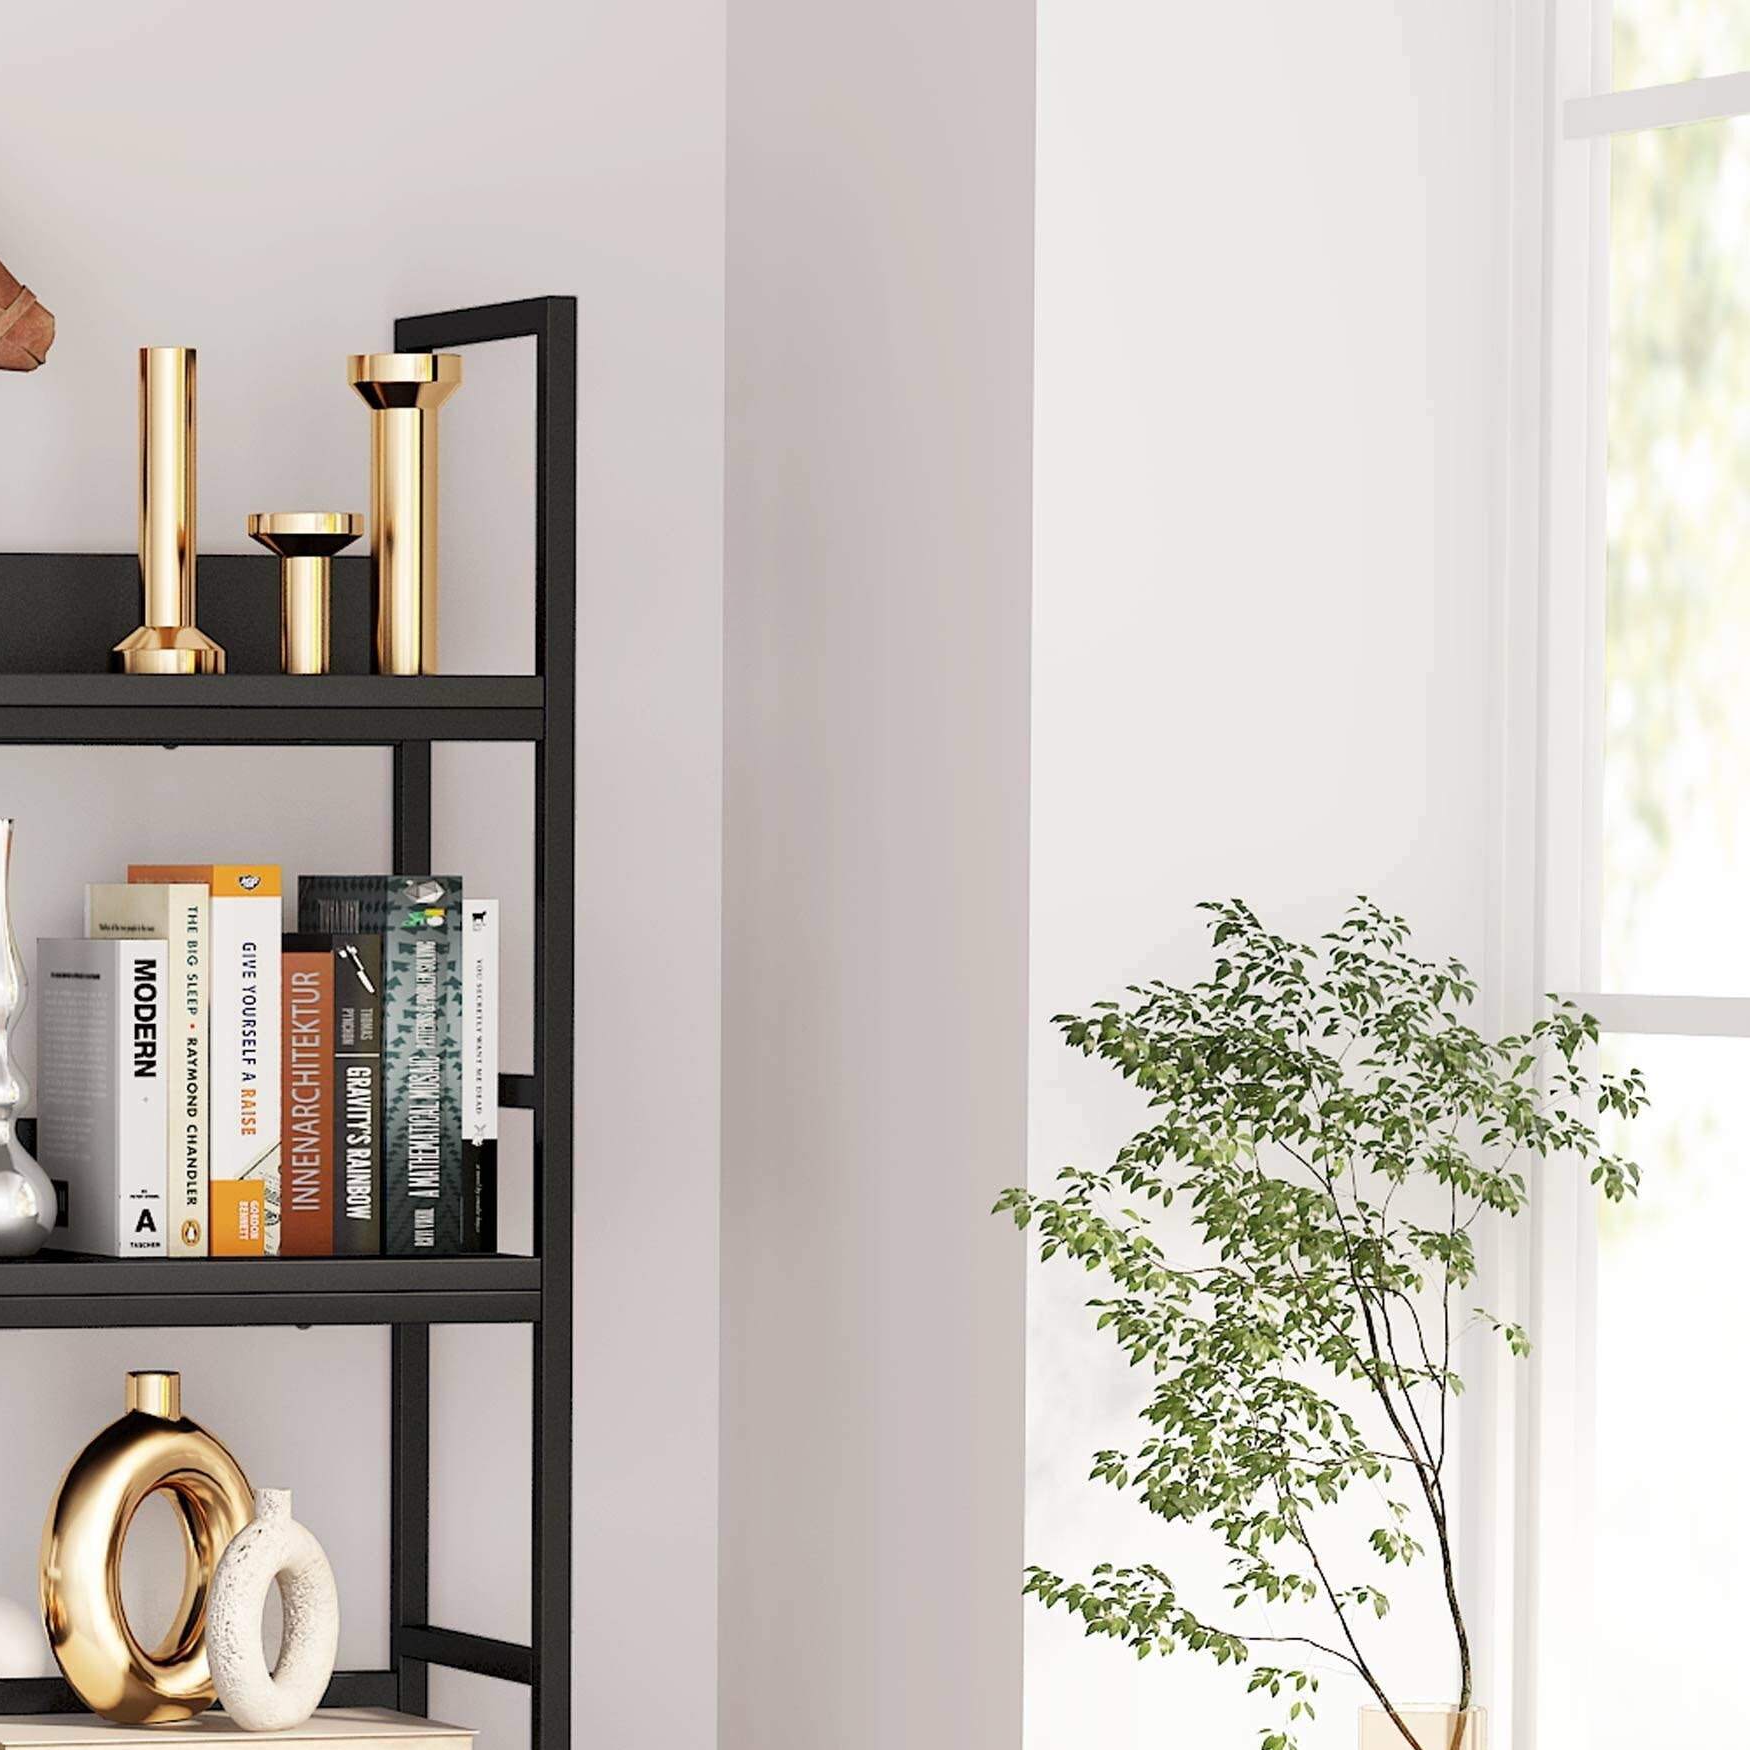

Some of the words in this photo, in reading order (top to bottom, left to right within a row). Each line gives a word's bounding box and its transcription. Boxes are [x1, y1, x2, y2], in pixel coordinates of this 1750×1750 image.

[186, 906, 198, 933] THE
[186, 940, 198, 966] BIG
[242, 942, 257, 978] GIVE
[186, 974, 198, 1015] SLEEP
[134, 959, 157, 1077] MODERN
[242, 985, 257, 1065] YOURSELF
[187, 1037, 198, 1117] RAYMOND
[242, 1072, 257, 1081] A
[291, 972, 320, 1211] INNENARCHITEKTUR
[408, 1055, 440, 1099] MOSAIC
[476, 1068, 483, 1082] ME
[241, 1088, 257, 1136] RAISE
[346, 1066, 372, 1145] GRAVITY'S
[187, 1124, 198, 1205] CHANDLER
[408, 1101, 440, 1187] MATHEMATICAL
[346, 1147, 372, 1220] RAINBOW
[408, 1189, 440, 1198] A
[135, 1208, 157, 1233] A
